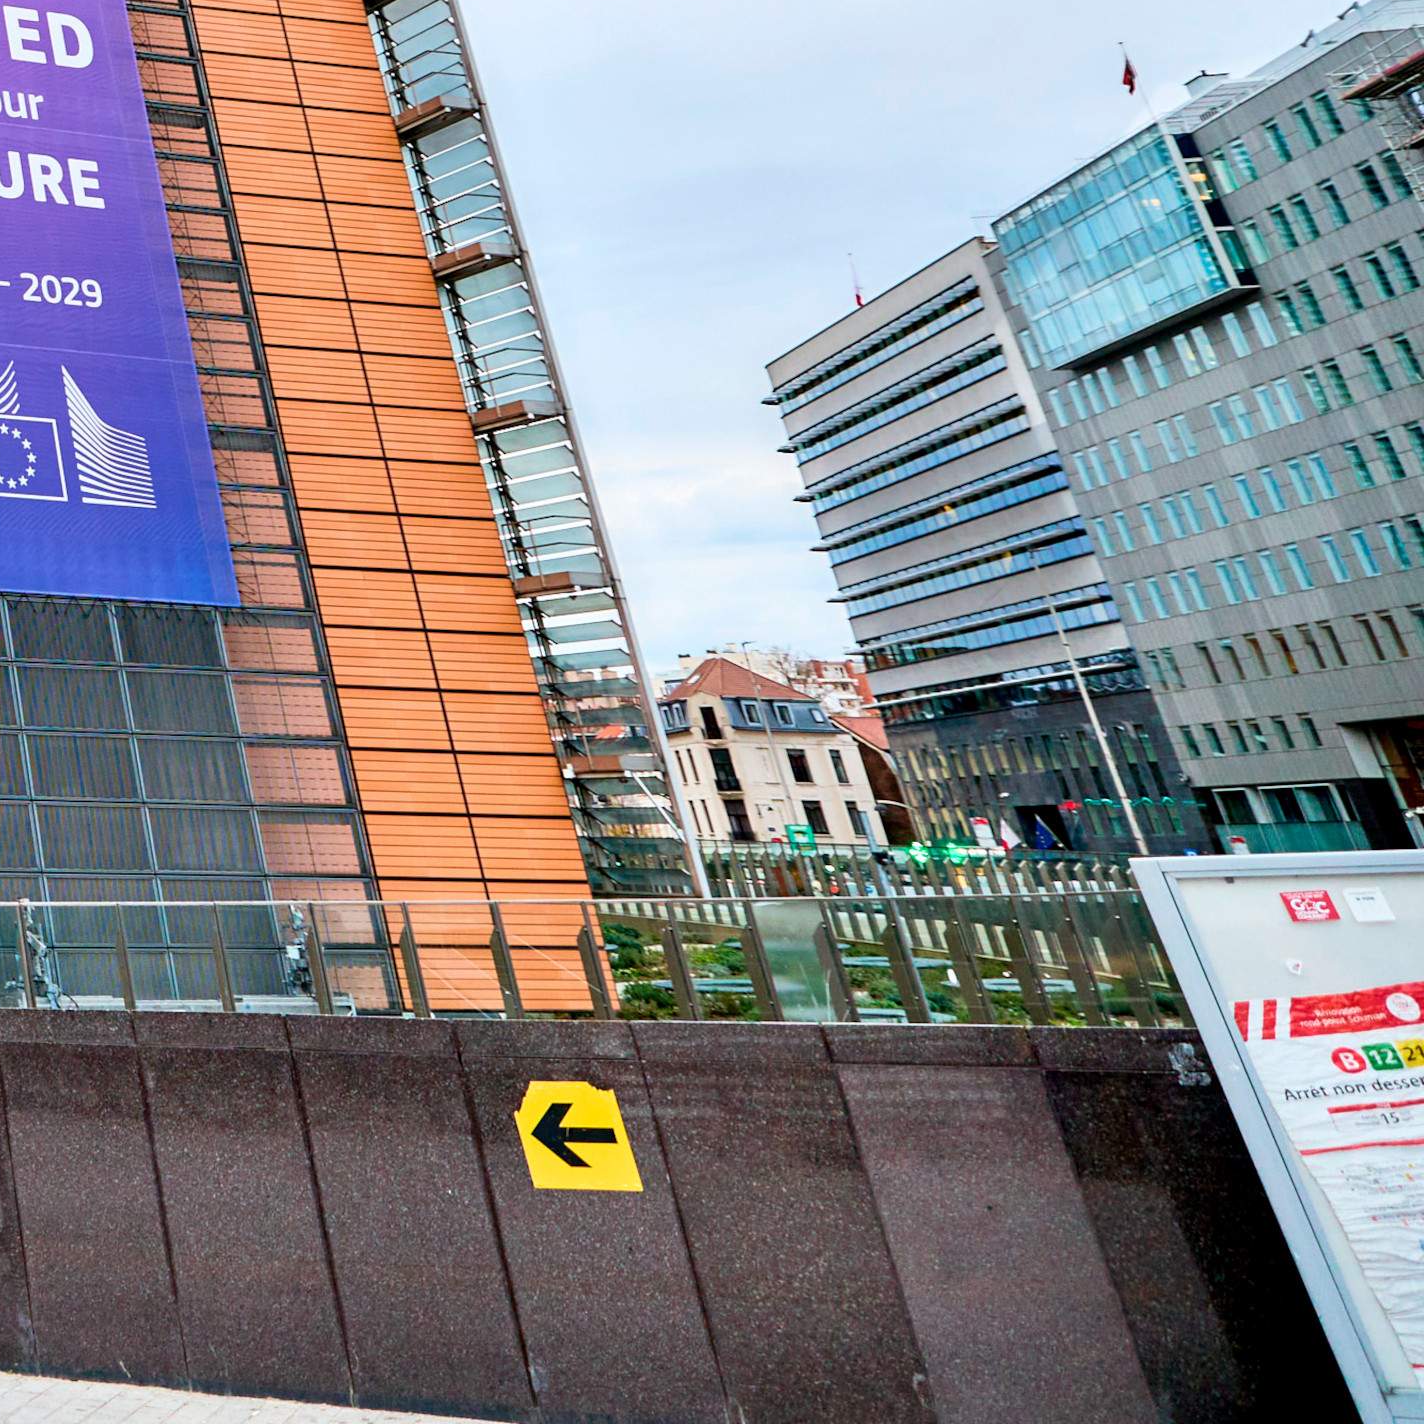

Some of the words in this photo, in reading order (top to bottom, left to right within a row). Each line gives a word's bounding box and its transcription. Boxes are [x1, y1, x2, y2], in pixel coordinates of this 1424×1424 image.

[19, 272, 104, 308] 2029
[1338, 1052, 1360, 1070] B
[1369, 1048, 1397, 1065] 12
[1333, 1083, 1366, 1096] non
[1380, 1111, 1400, 1125] 15
